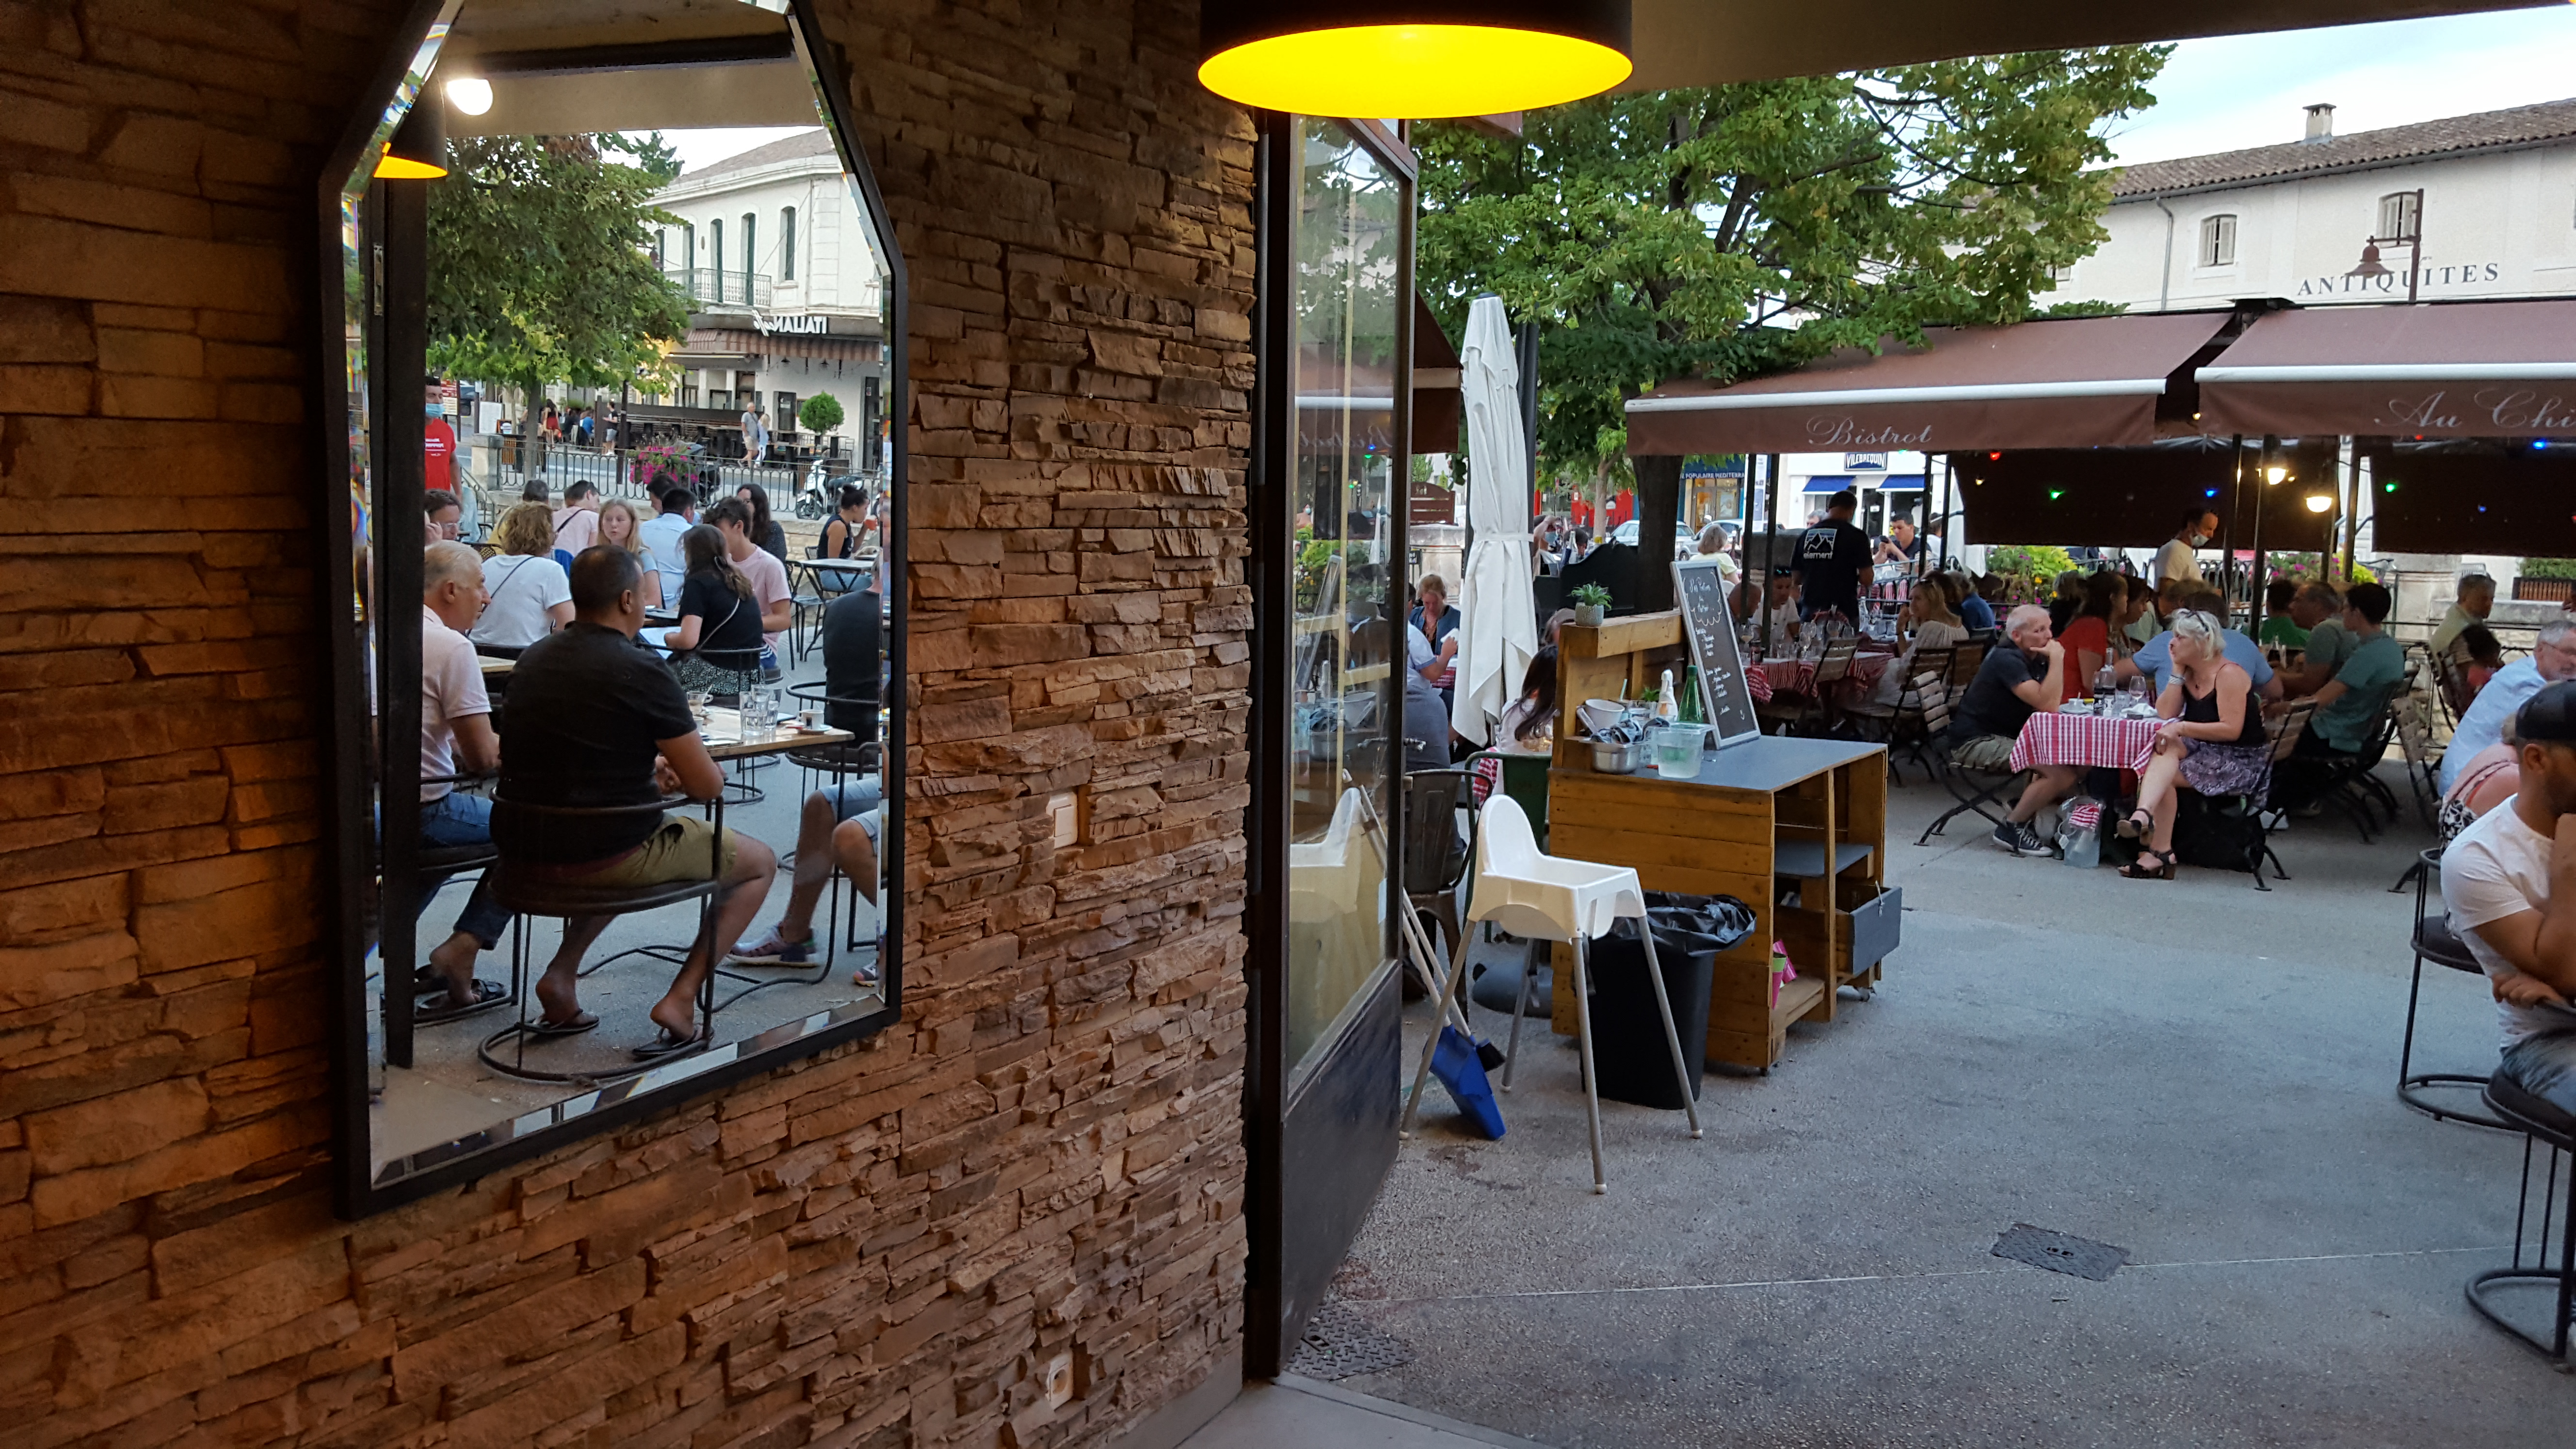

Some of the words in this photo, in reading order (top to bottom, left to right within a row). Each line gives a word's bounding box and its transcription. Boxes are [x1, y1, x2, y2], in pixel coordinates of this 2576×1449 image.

[2297, 263, 2498, 295] ANTIQUITES
[2373, 390, 2463, 428] Au
[2474, 387, 2576, 428] Chi
[1806, 413, 1932, 446] Bistrot
[1846, 453, 1885, 468] VILEBREQUIN
[1803, 551, 1833, 559] element
